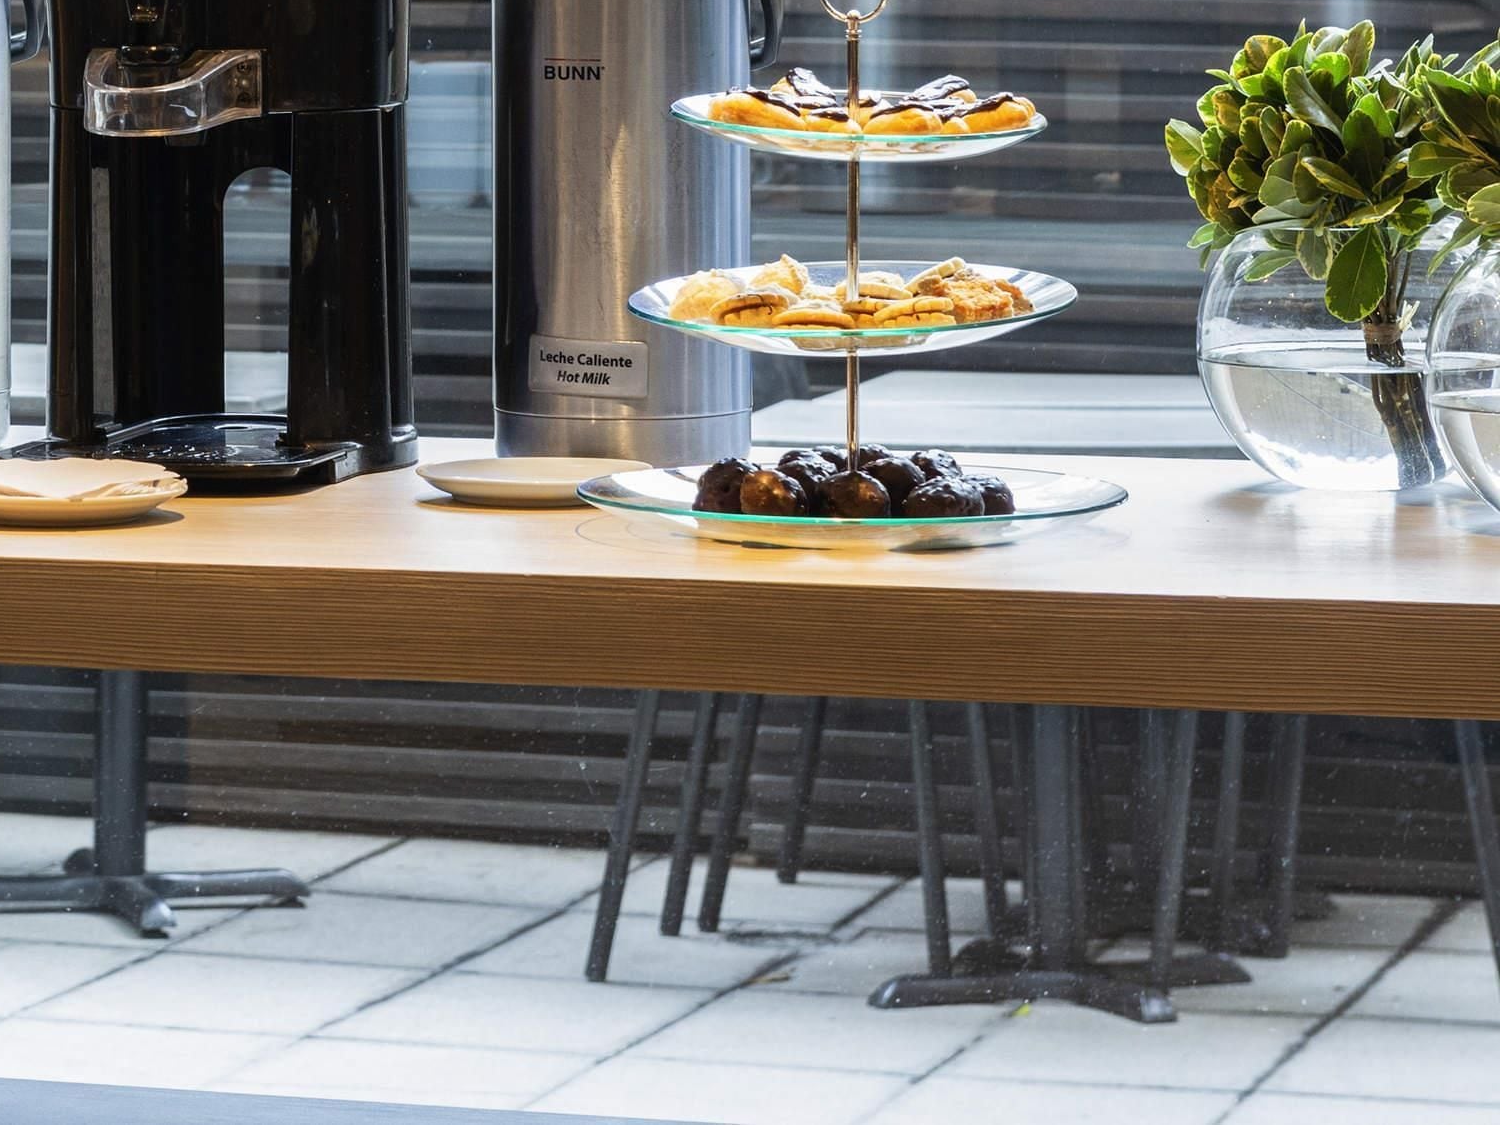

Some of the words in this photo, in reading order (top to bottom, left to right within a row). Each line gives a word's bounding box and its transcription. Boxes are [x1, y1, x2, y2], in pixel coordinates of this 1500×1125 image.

[544, 66, 600, 80] BUNN
[540, 350, 574, 364] Leche
[577, 354, 633, 368] Caliente
[556, 370, 580, 383] Hot
[581, 372, 611, 385] Milk
